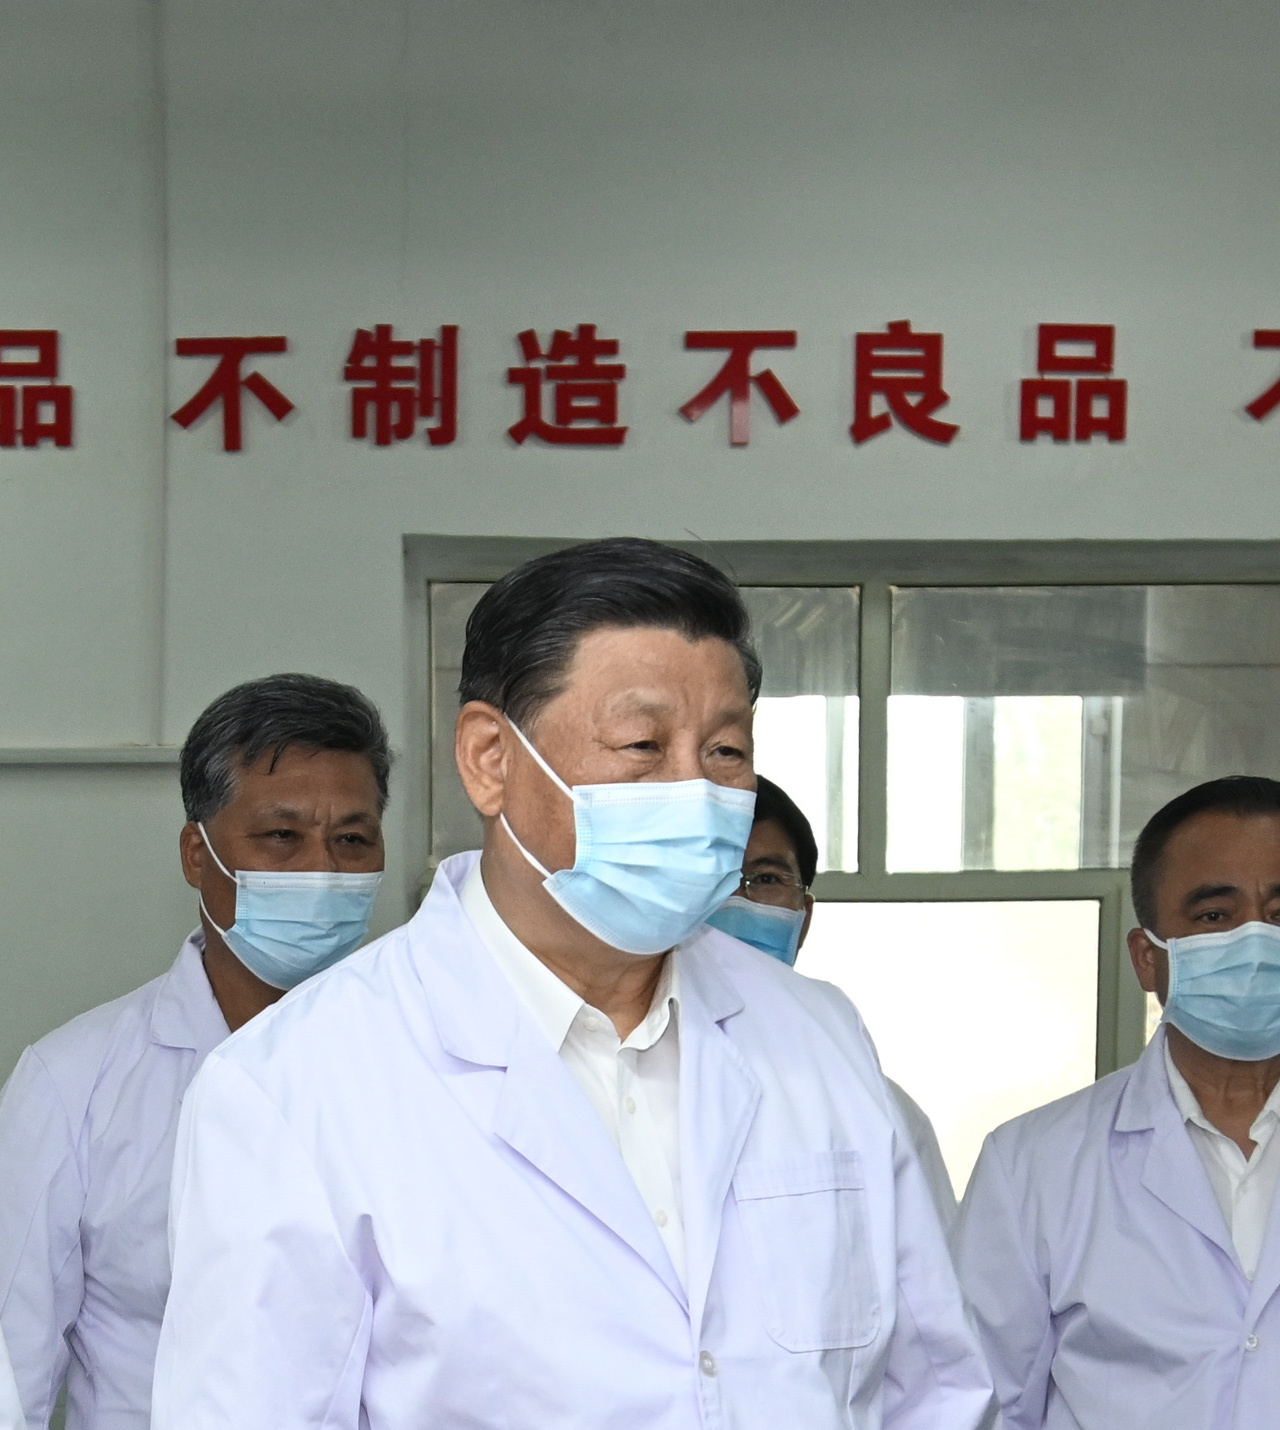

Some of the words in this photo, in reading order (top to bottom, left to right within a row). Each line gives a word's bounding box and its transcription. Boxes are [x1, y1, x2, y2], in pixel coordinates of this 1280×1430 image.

[173, 322, 1125, 449] 不制造不良品
